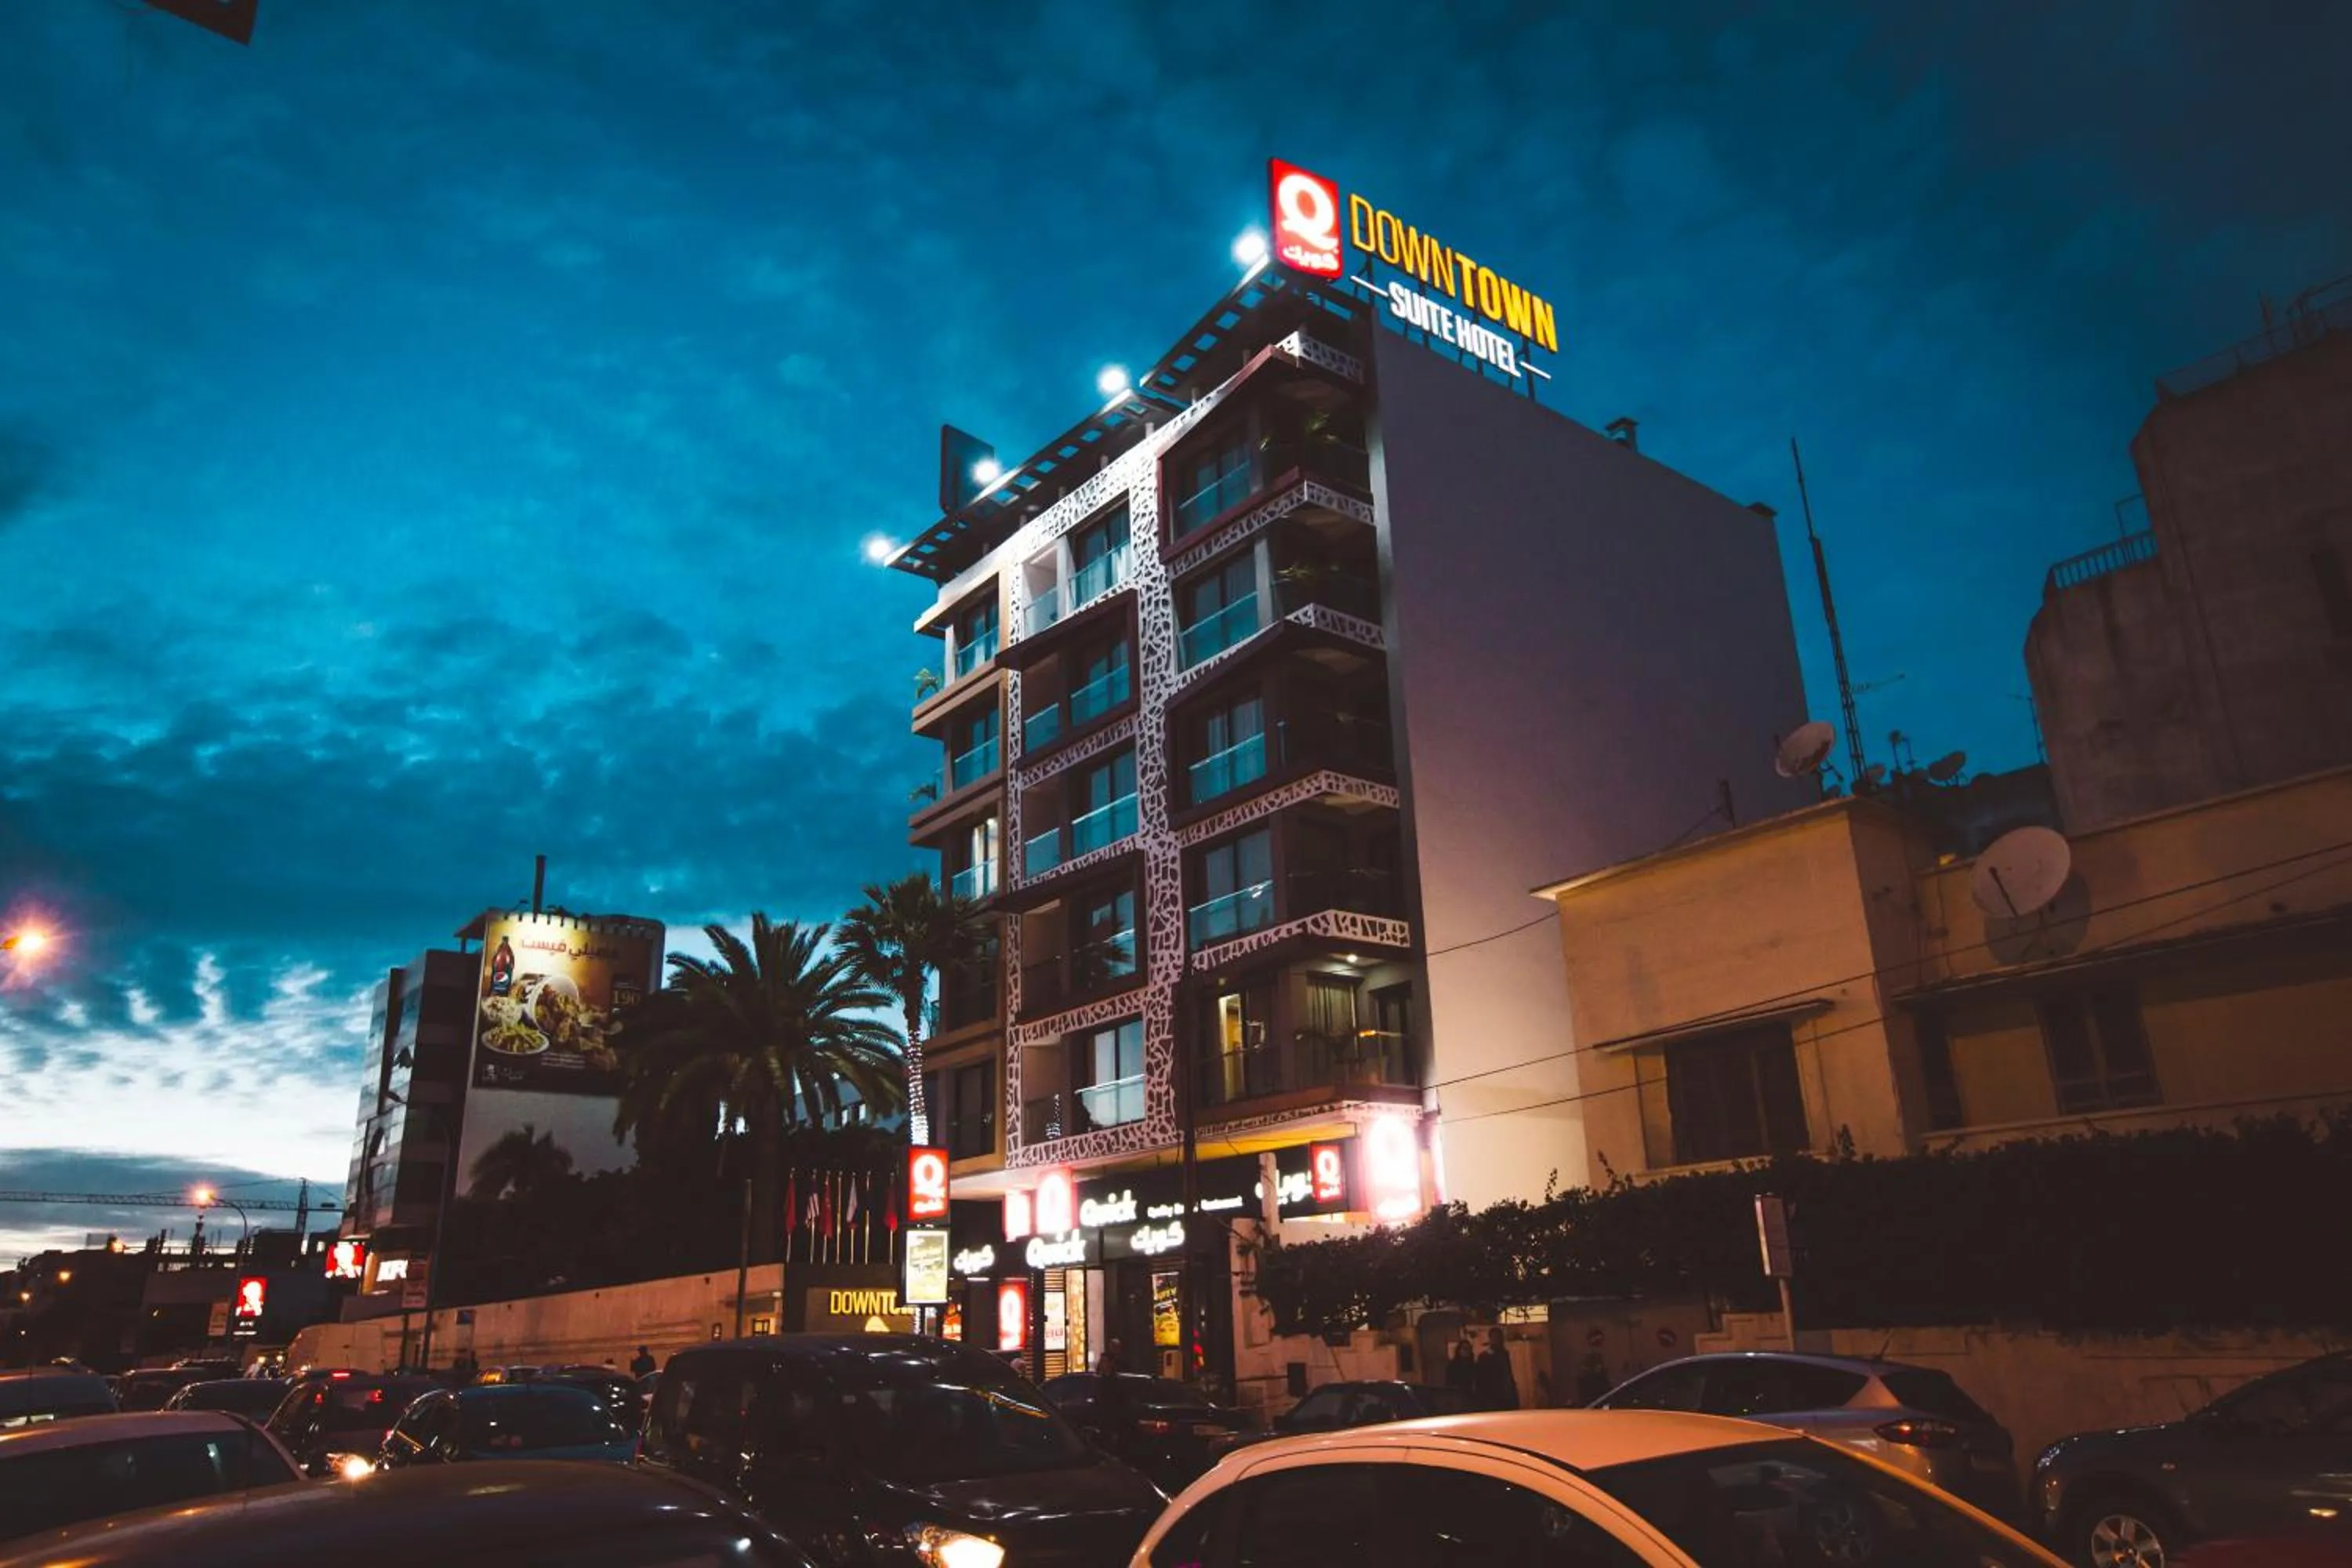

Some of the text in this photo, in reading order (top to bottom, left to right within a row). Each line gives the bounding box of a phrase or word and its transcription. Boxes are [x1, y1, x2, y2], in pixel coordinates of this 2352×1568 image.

[1278, 172, 1338, 251] Q
[1388, 281, 1522, 378] SUITE HOTEL
[830, 1291, 913, 1315] DOWNTO
